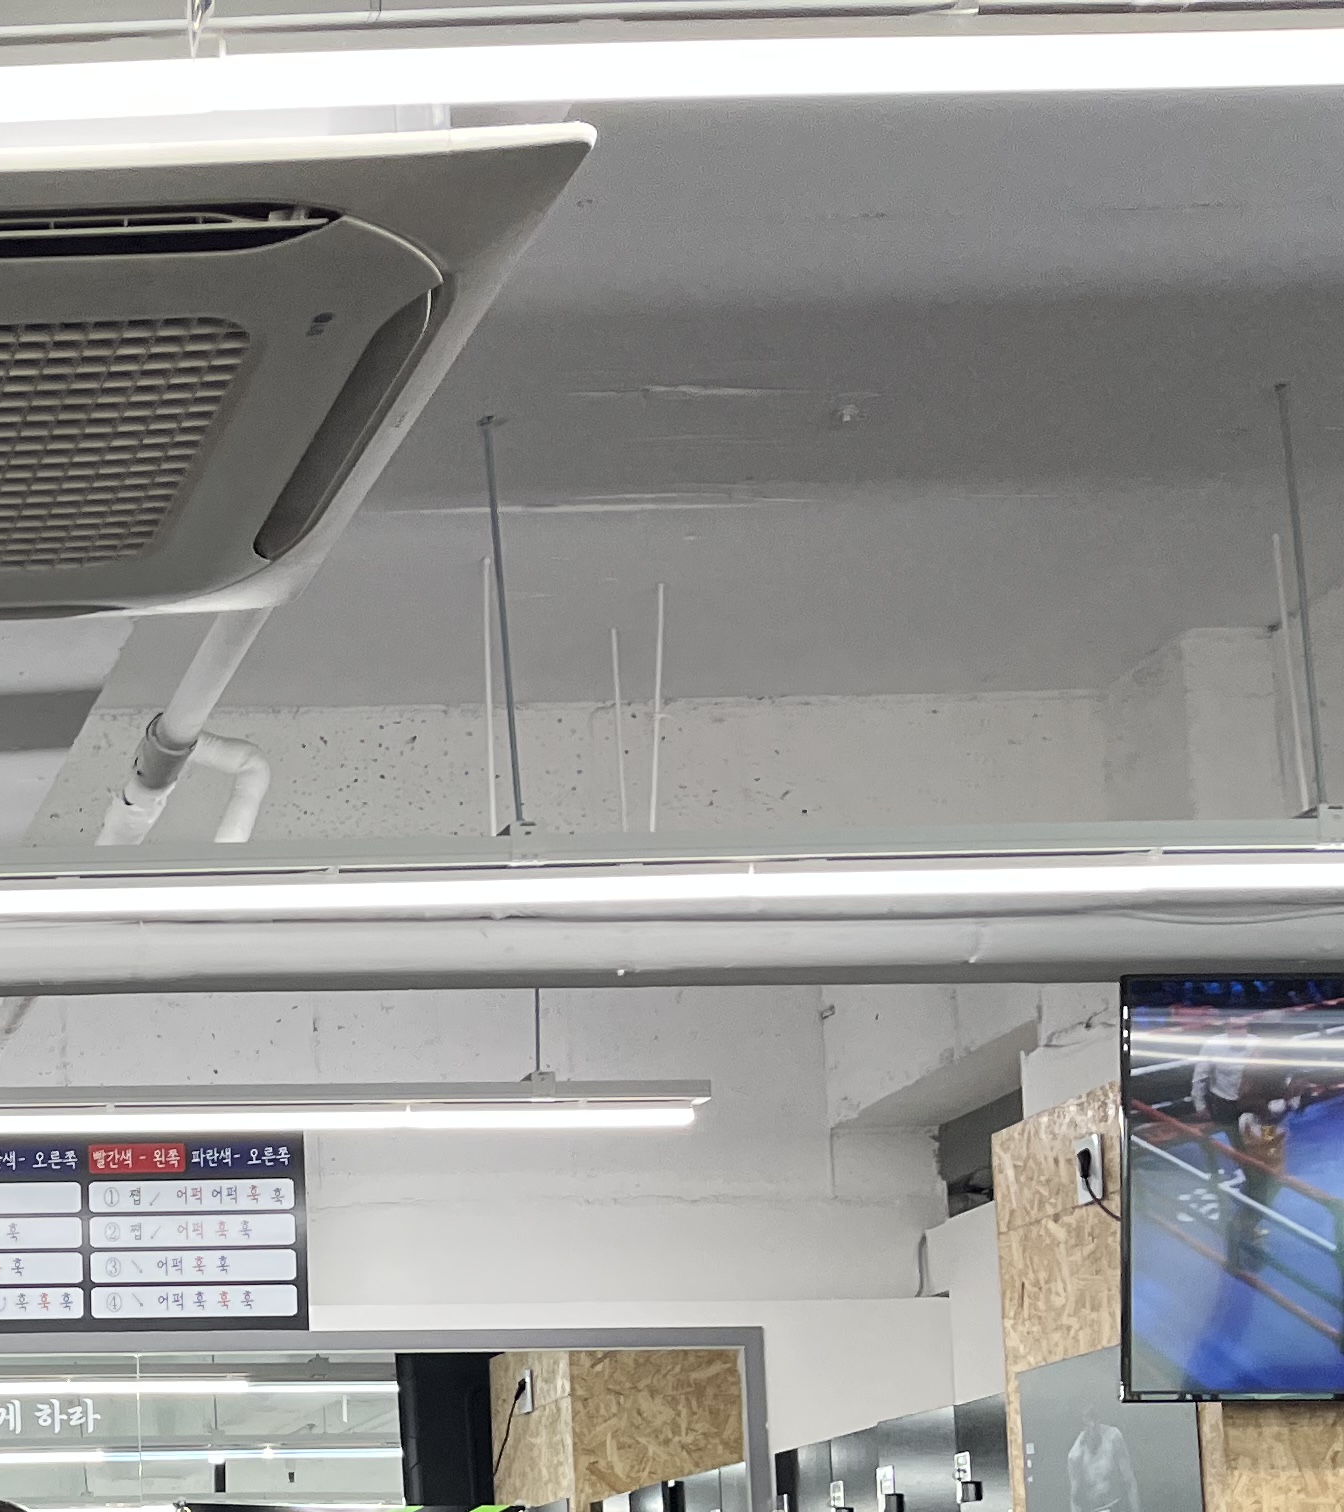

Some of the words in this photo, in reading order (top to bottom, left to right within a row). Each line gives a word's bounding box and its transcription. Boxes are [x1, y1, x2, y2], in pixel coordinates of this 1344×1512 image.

[32, 1150, 78, 1169] 오른쪽
[93, 1149, 133, 1169] 빨간색
[153, 1149, 180, 1168] 왼쪽
[247, 1147, 291, 1166] 오른쪽
[34, 1398, 101, 1434] 하라
